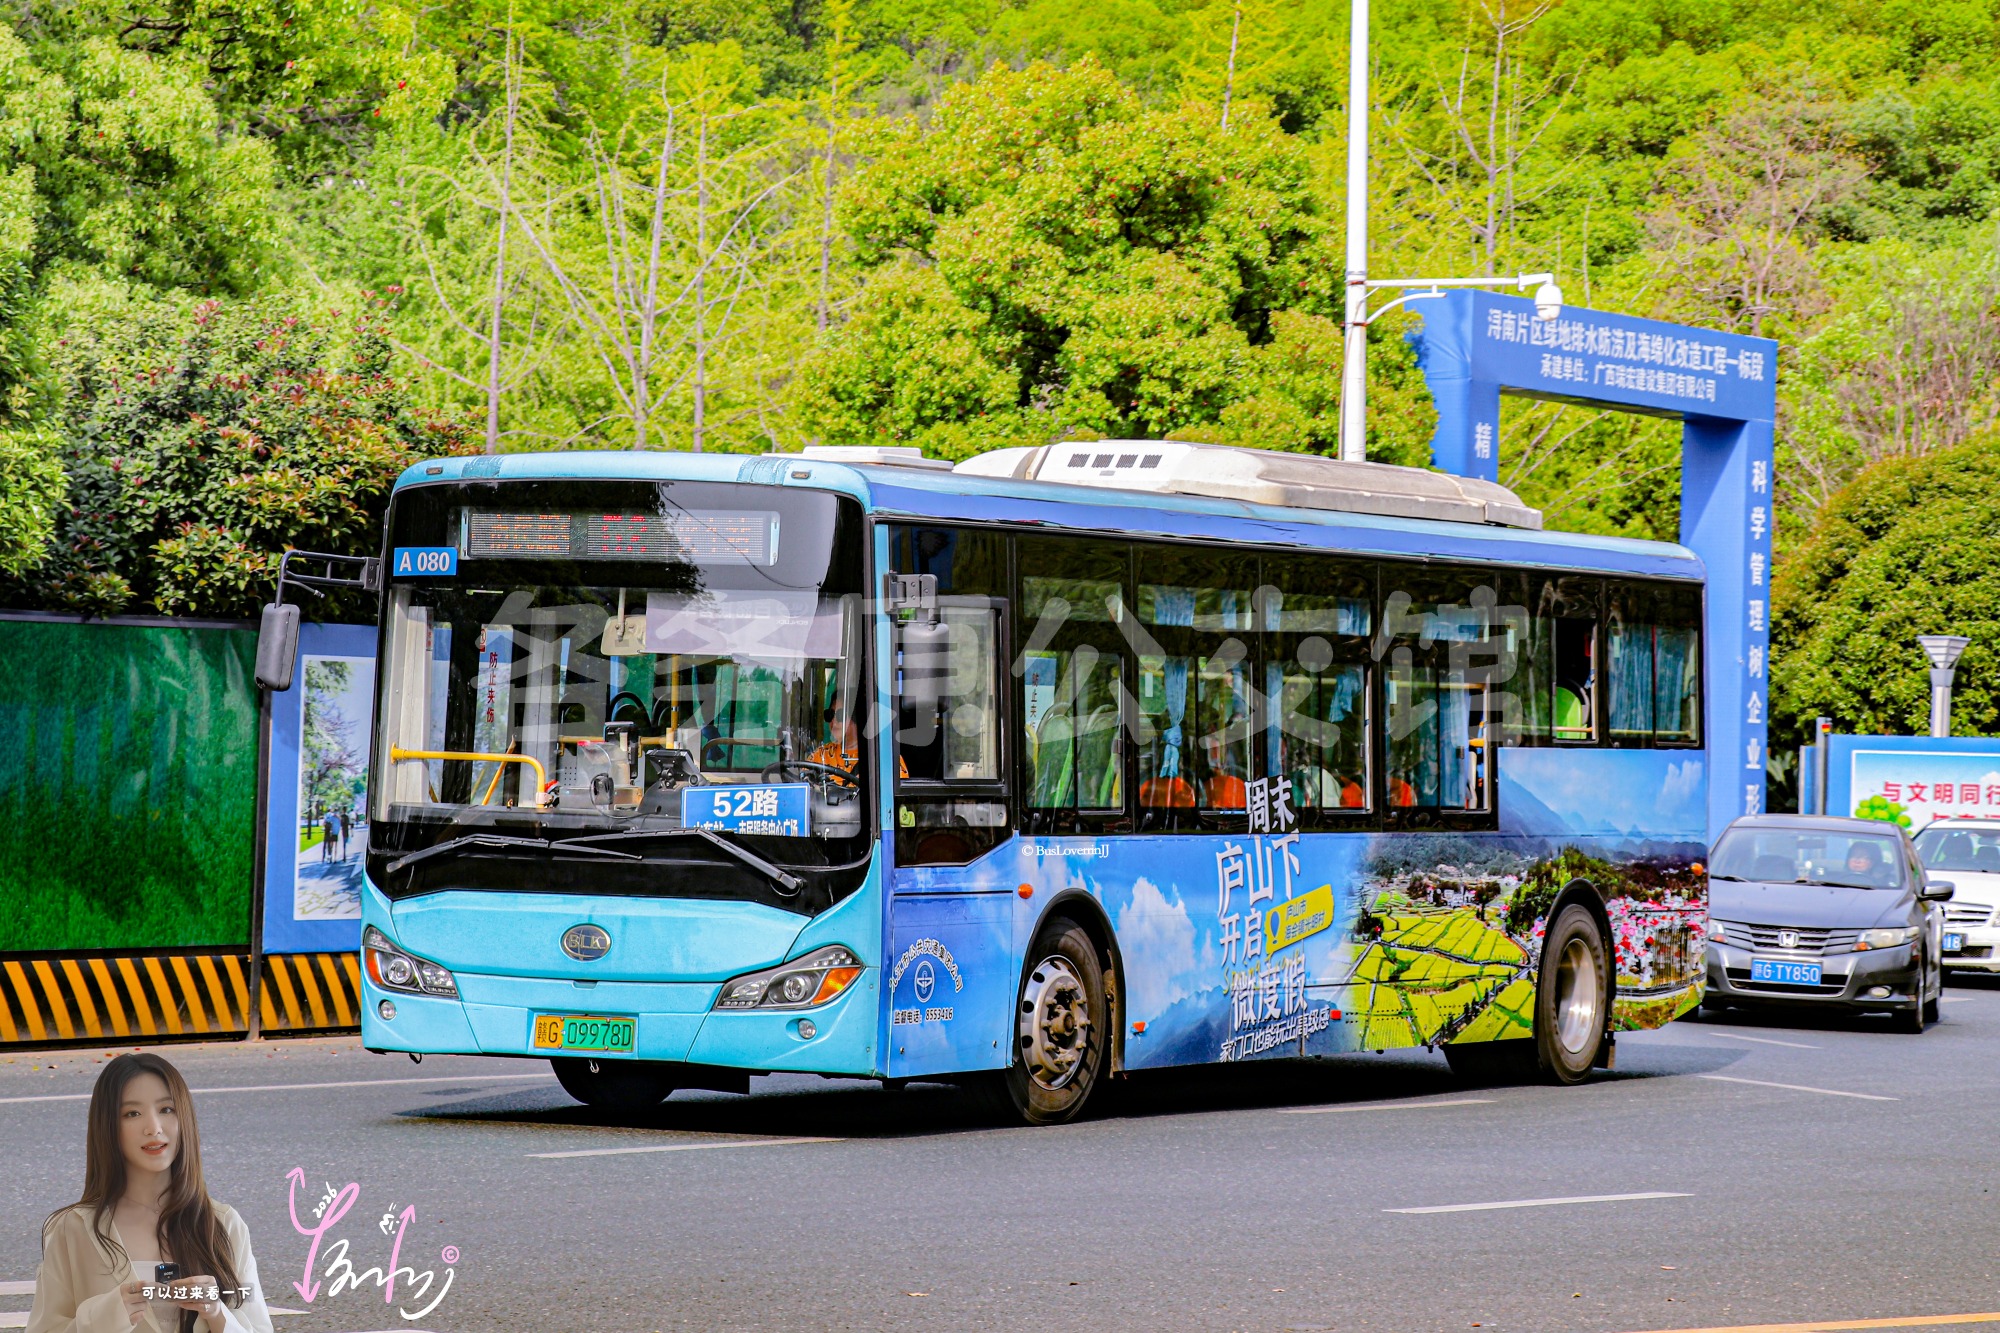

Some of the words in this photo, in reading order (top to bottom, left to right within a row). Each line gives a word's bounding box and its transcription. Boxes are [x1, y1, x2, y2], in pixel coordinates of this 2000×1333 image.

[1474, 421, 1492, 479] 精
[400, 551, 412, 572] A
[417, 551, 450, 572] 080
[713, 790, 778, 817] 52路
[1245, 774, 1295, 834] 周末
[1215, 829, 1301, 918] 庐山下
[1220, 908, 1262, 966] 开启
[1230, 953, 1308, 1032] 微度假
